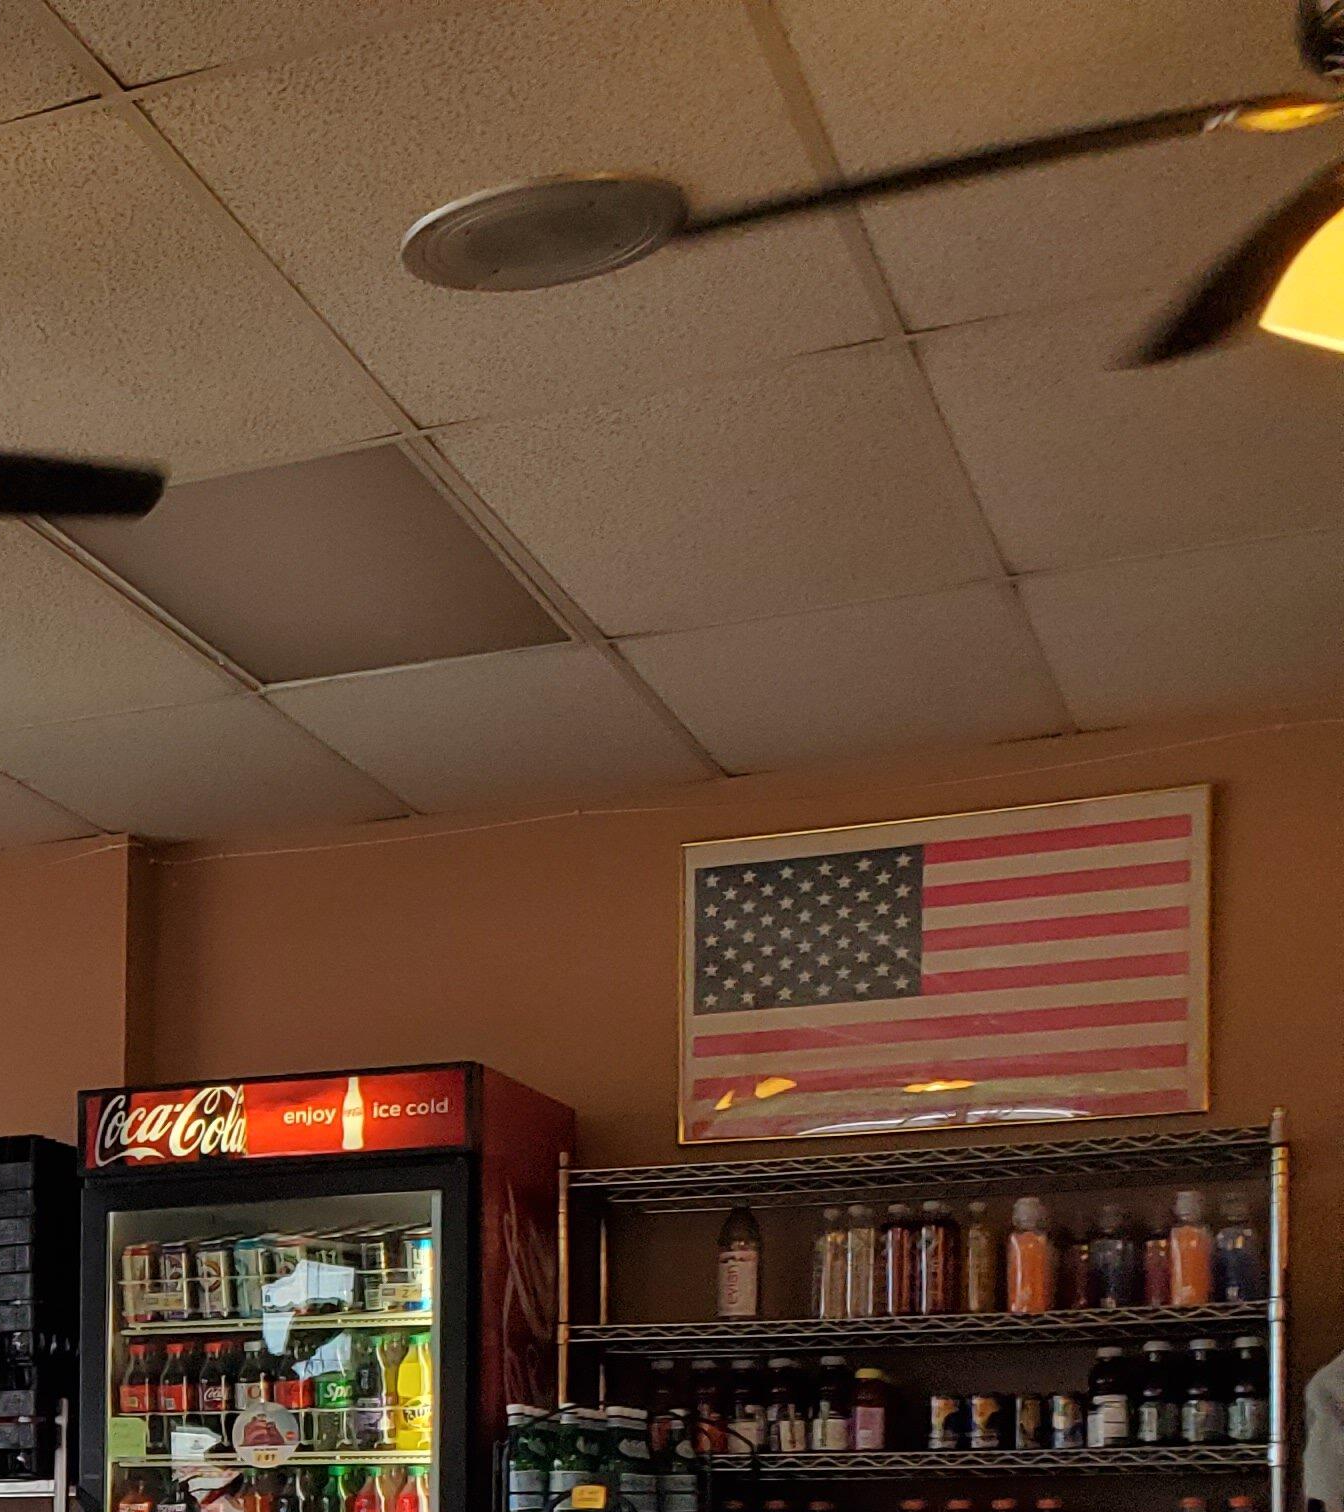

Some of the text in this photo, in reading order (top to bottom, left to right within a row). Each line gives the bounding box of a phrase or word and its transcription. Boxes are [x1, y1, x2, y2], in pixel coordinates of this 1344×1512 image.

[95, 1084, 247, 1167] Coca-Cola
[283, 1097, 450, 1127] enjoy ice cold
